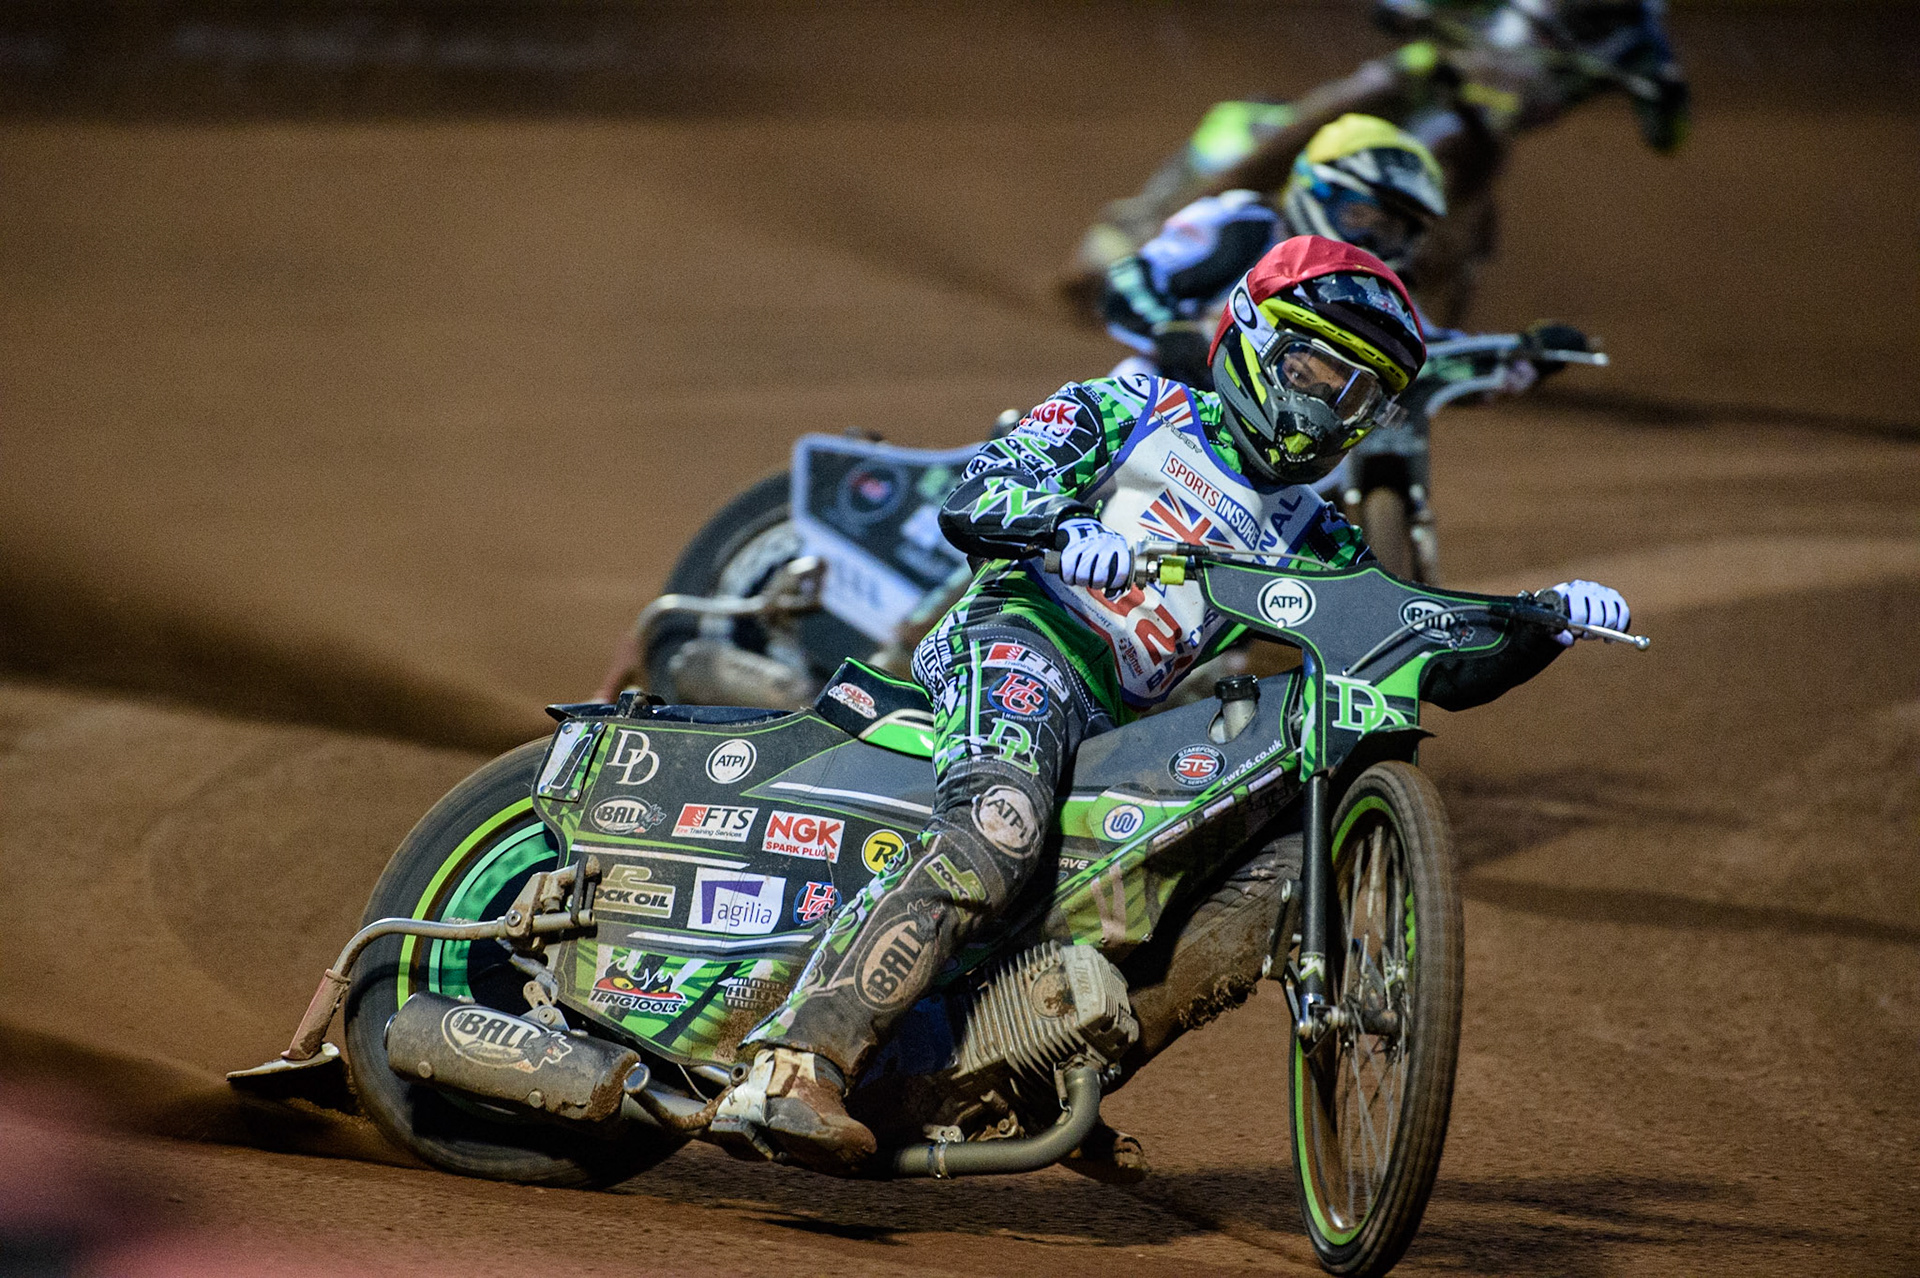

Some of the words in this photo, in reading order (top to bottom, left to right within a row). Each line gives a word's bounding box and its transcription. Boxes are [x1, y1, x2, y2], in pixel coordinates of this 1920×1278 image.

[1031, 402, 1076, 426] NGK
[1166, 457, 1220, 508] SPORTS
[1217, 497, 1260, 550] INSURE
[1269, 595, 1303, 609] ATPI
[715, 754, 746, 767] ATPI
[1177, 745, 1219, 757] STAKEFORD
[1176, 758, 1215, 772] STS
[1221, 739, 1284, 786] cwr26.co.uk
[600, 805, 644, 825] BALL
[701, 807, 753, 830] FTS
[988, 797, 1029, 840] ATPI
[690, 828, 714, 836] Training
[715, 830, 742, 838] Services
[767, 814, 841, 850] NGK
[765, 841, 800, 855] SPARK
[1058, 857, 1089, 871] AVE
[595, 888, 636, 904] OCK
[634, 893, 669, 909] OIL
[717, 901, 773, 927] agilia
[460, 1012, 536, 1049] BALL
